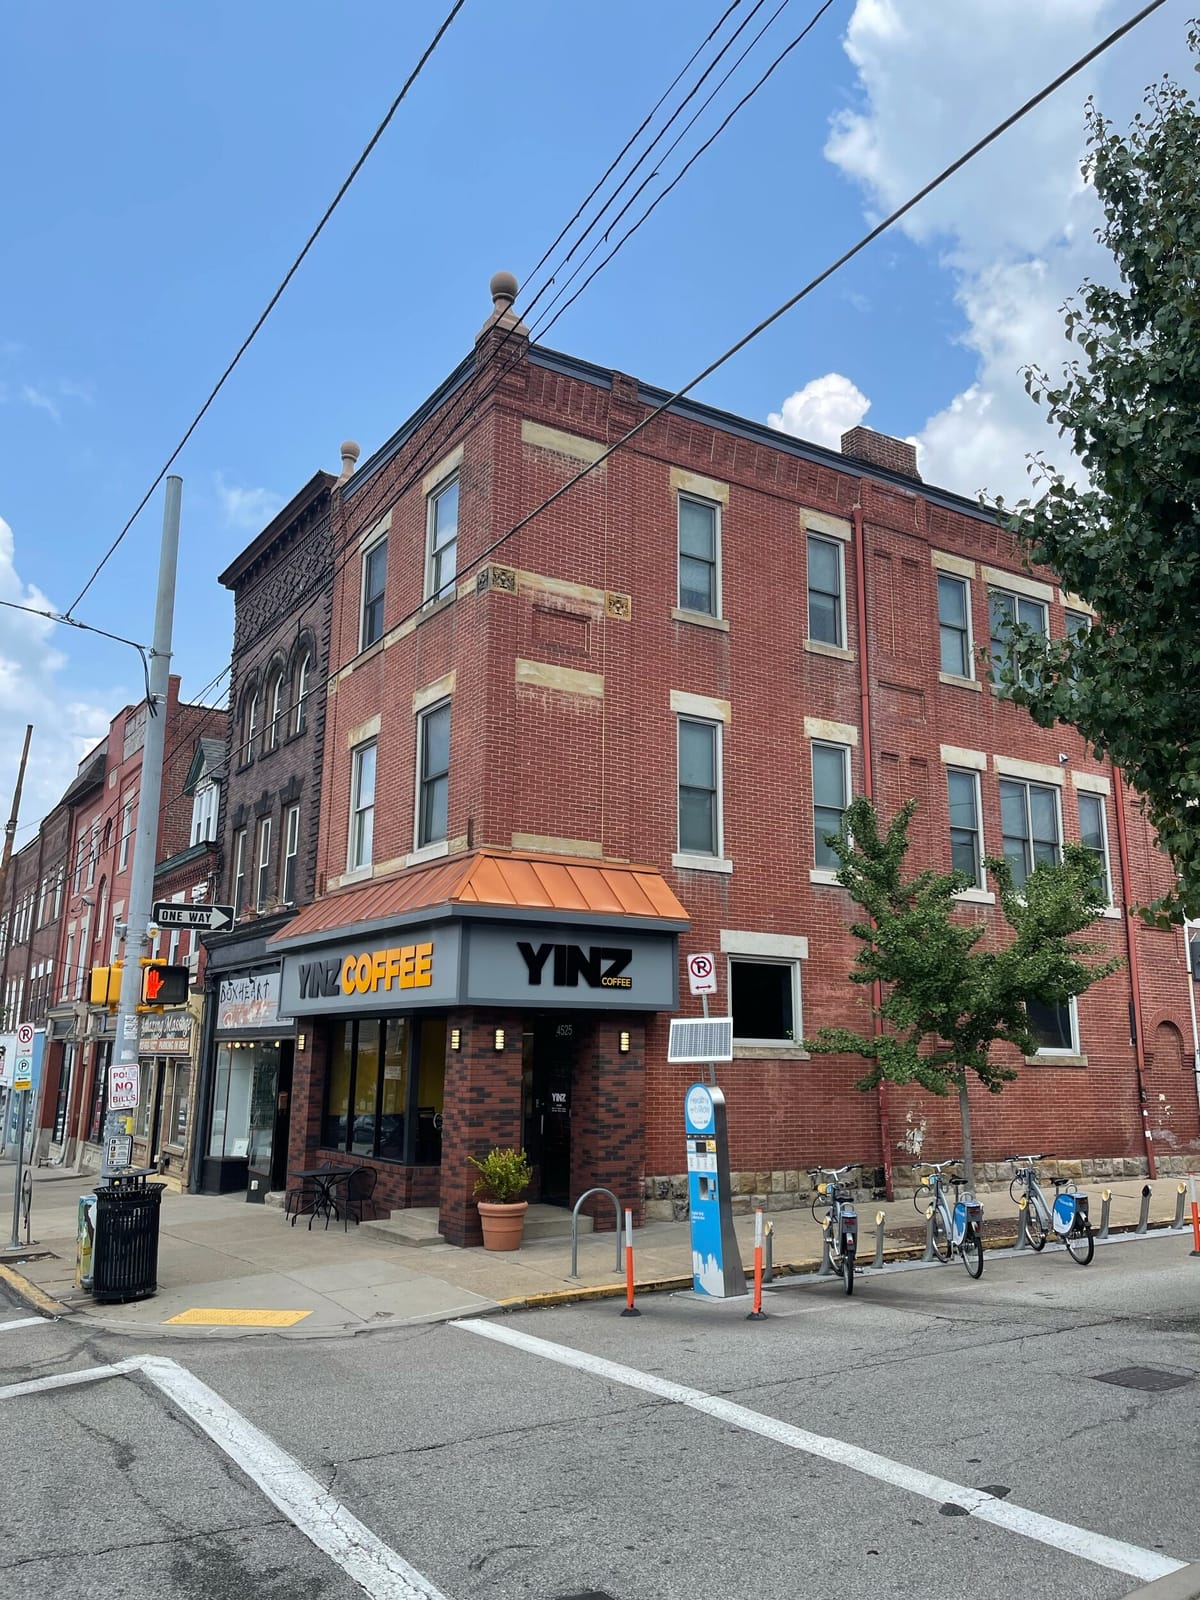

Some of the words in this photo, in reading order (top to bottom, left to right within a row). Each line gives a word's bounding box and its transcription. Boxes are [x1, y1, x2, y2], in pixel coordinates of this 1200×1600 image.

[161, 910, 183, 921] ONE
[189, 912, 212, 923] WAY
[299, 958, 342, 999] YINZ
[341, 943, 433, 995] COFFEE
[516, 942, 632, 990] YINZ
[601, 977, 631, 987] COFFEE
[220, 979, 269, 1003] BOXHEART
[164, 1015, 191, 1038] Massage
[556, 1024, 573, 1036] 4525
[115, 1081, 133, 1092] NO
[112, 1094, 136, 1103] BILLS
[552, 1093, 566, 1102] YINZ
